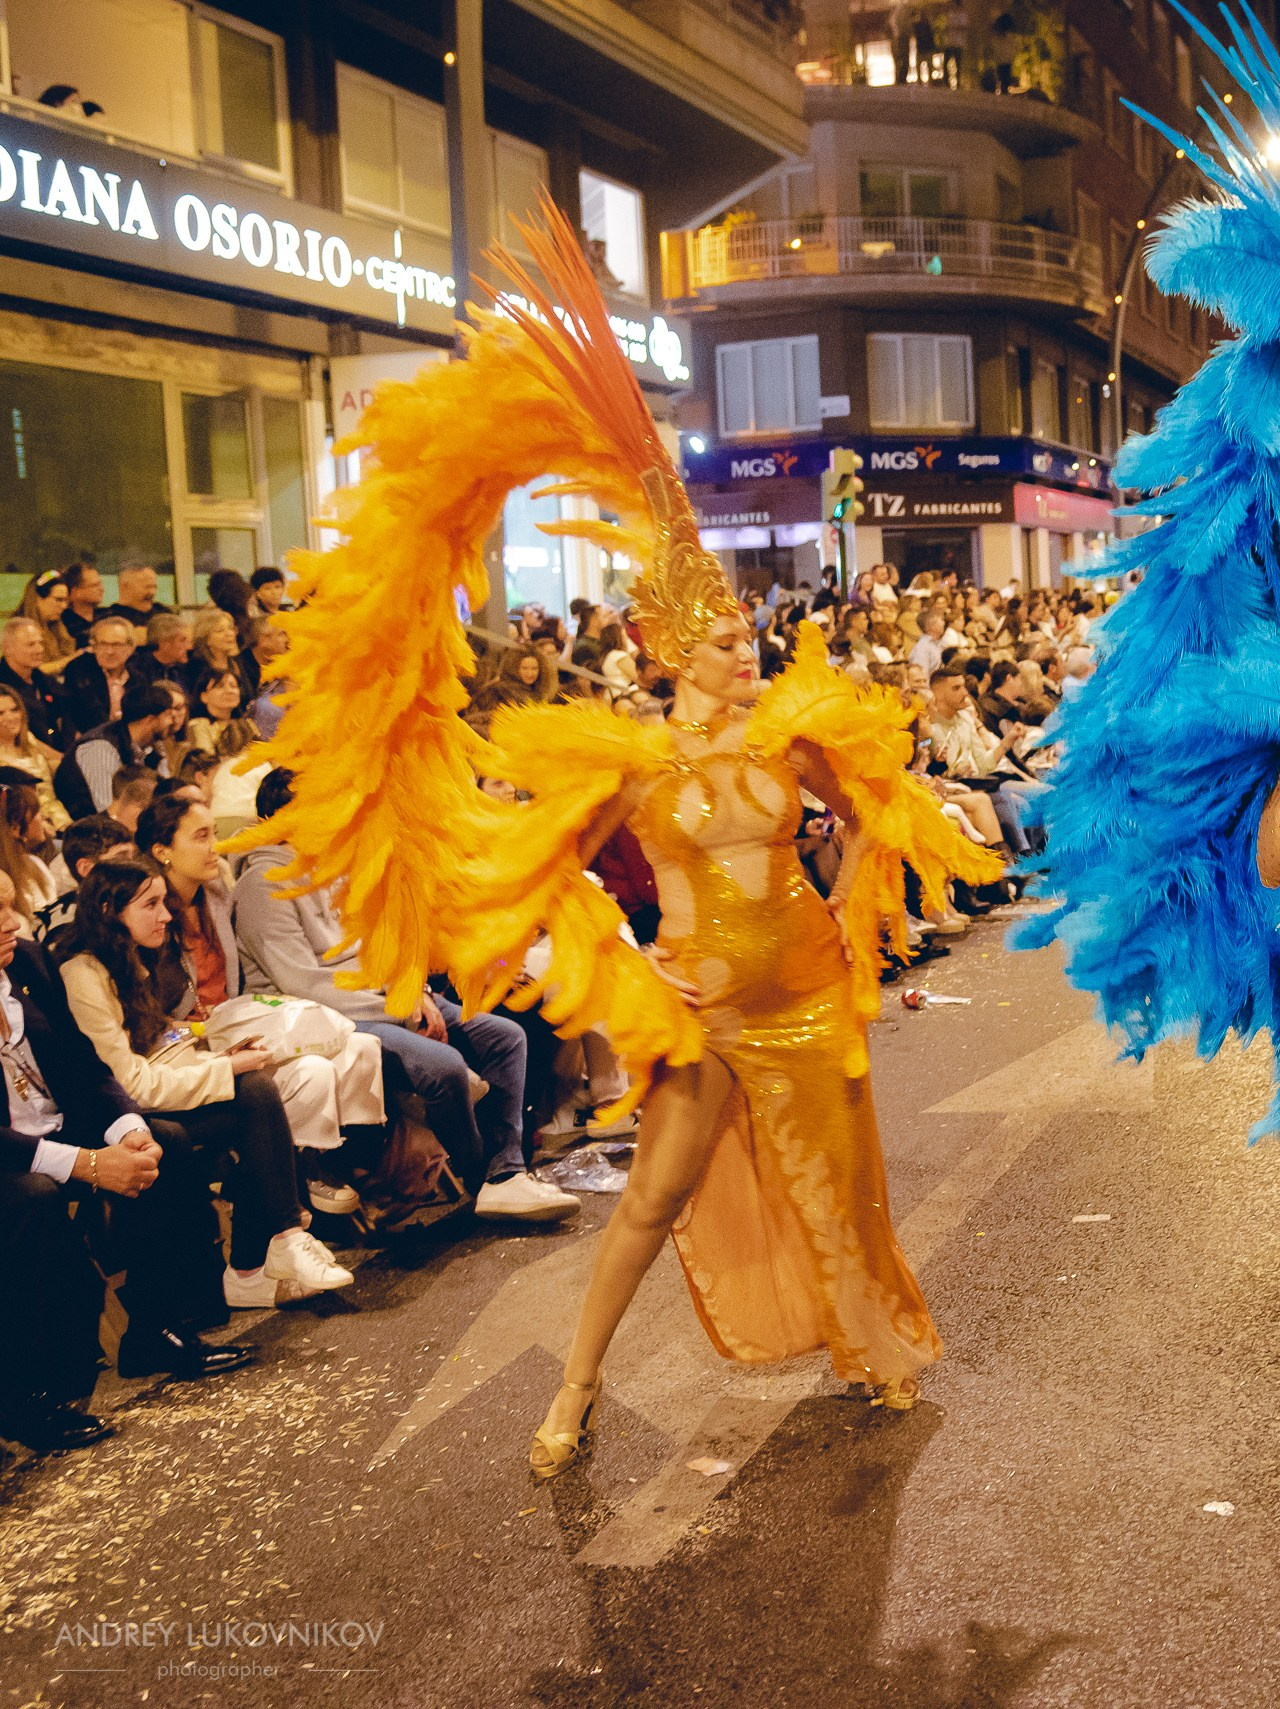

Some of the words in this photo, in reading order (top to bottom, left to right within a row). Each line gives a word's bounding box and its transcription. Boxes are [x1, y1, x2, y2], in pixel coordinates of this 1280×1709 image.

[174, 194, 351, 288] OSORIO
[731, 458, 777, 479] MGS
[871, 451, 919, 470] MGS
[914, 503, 1003, 515] FABRICANTES
[697, 511, 770, 527] BRICANTES
